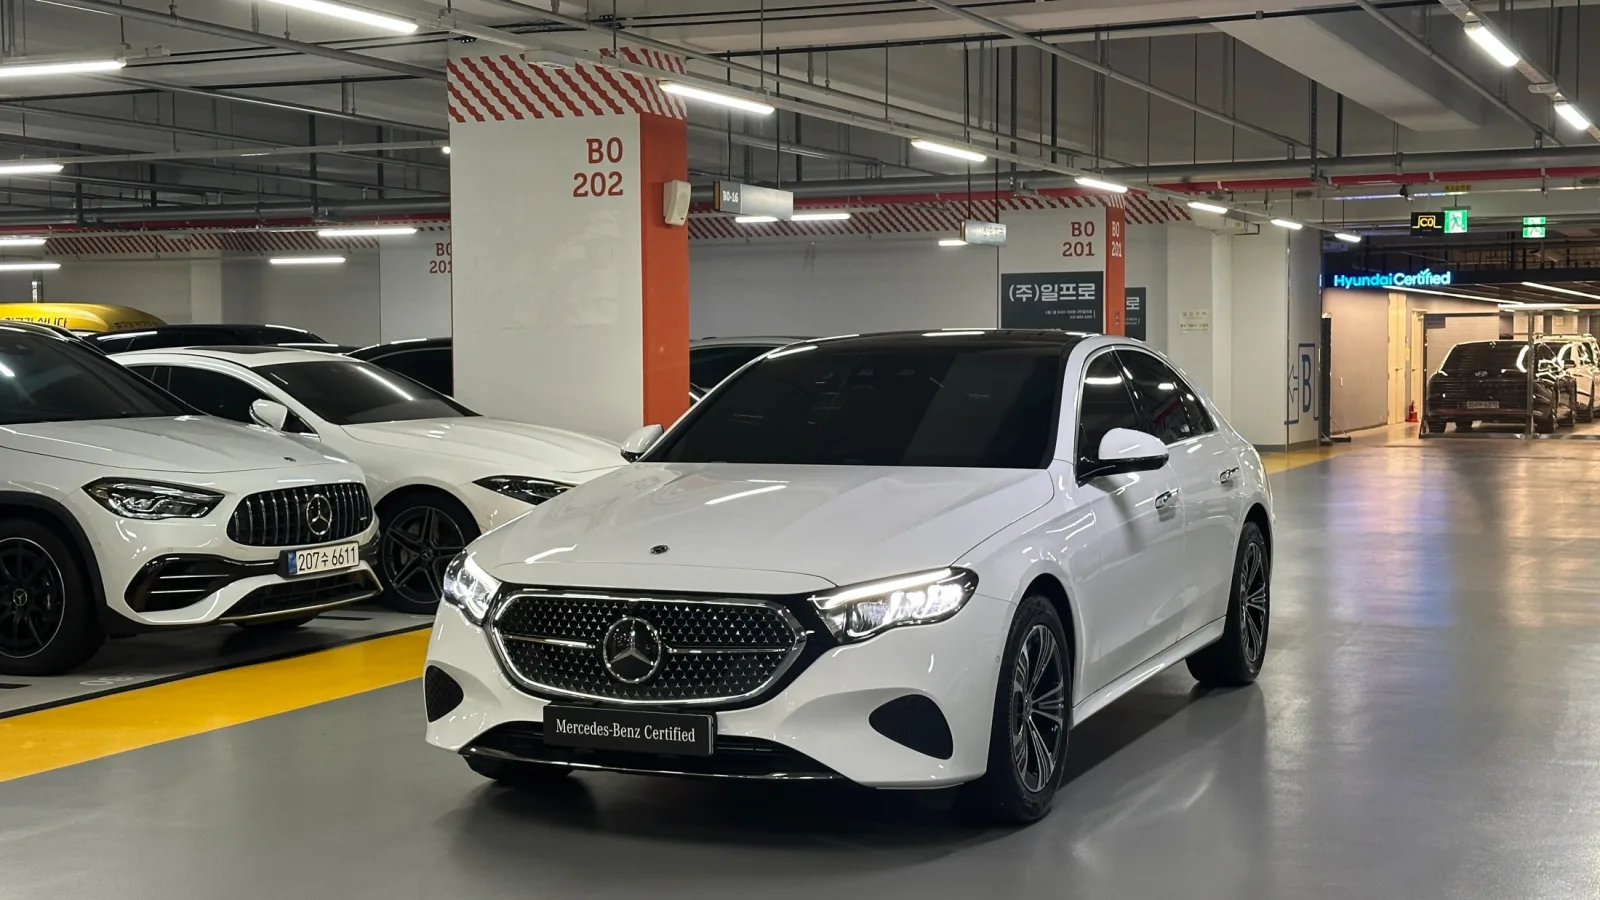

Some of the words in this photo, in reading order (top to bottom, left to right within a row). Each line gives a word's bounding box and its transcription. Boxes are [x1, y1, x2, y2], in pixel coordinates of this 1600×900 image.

[573, 171, 624, 197] 202
[1062, 241, 1095, 257] 201
[1111, 241, 1122, 257] 201
[1333, 273, 1393, 289] Hyundai
[1393, 268, 1451, 286] Certified
[1008, 283, 1096, 302] (주)일프로
[1302, 354, 1311, 412] B
[298, 551, 329, 572] 207수
[331, 545, 356, 566] 6611
[555, 718, 641, 739] Mercedes-Benz
[644, 724, 696, 743] Certified
